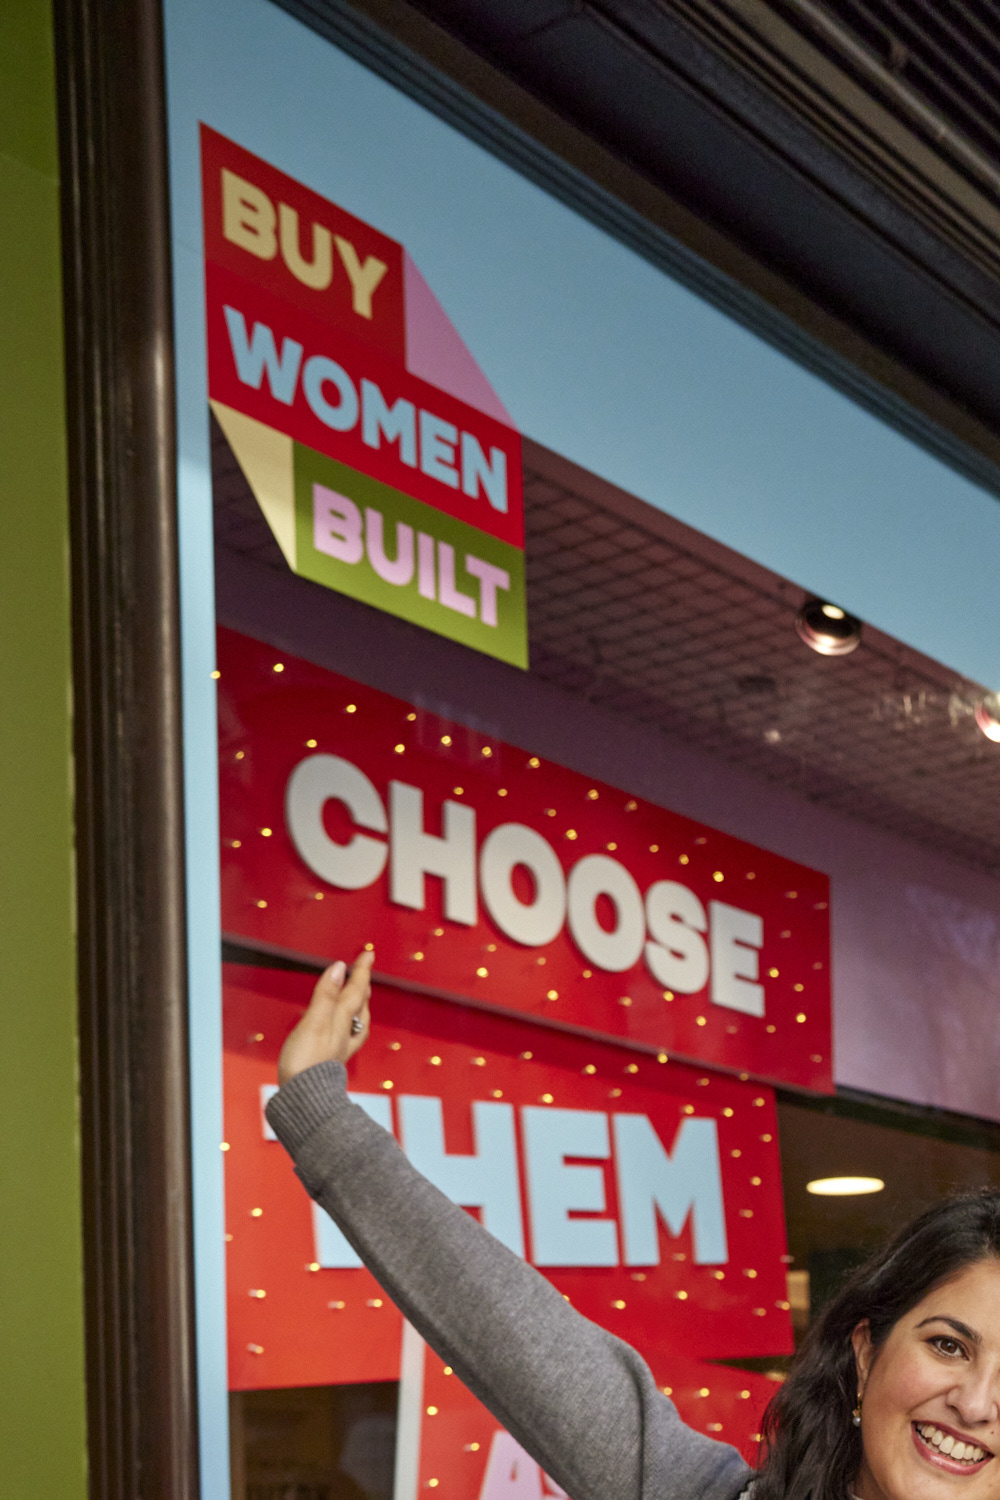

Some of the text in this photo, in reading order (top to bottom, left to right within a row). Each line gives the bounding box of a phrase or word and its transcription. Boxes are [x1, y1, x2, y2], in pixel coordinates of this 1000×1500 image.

[221, 167, 388, 320] BUY
[222, 304, 509, 514] WOMEN
[311, 482, 510, 628] BUILT
[284, 753, 766, 1019] CHOOSE
